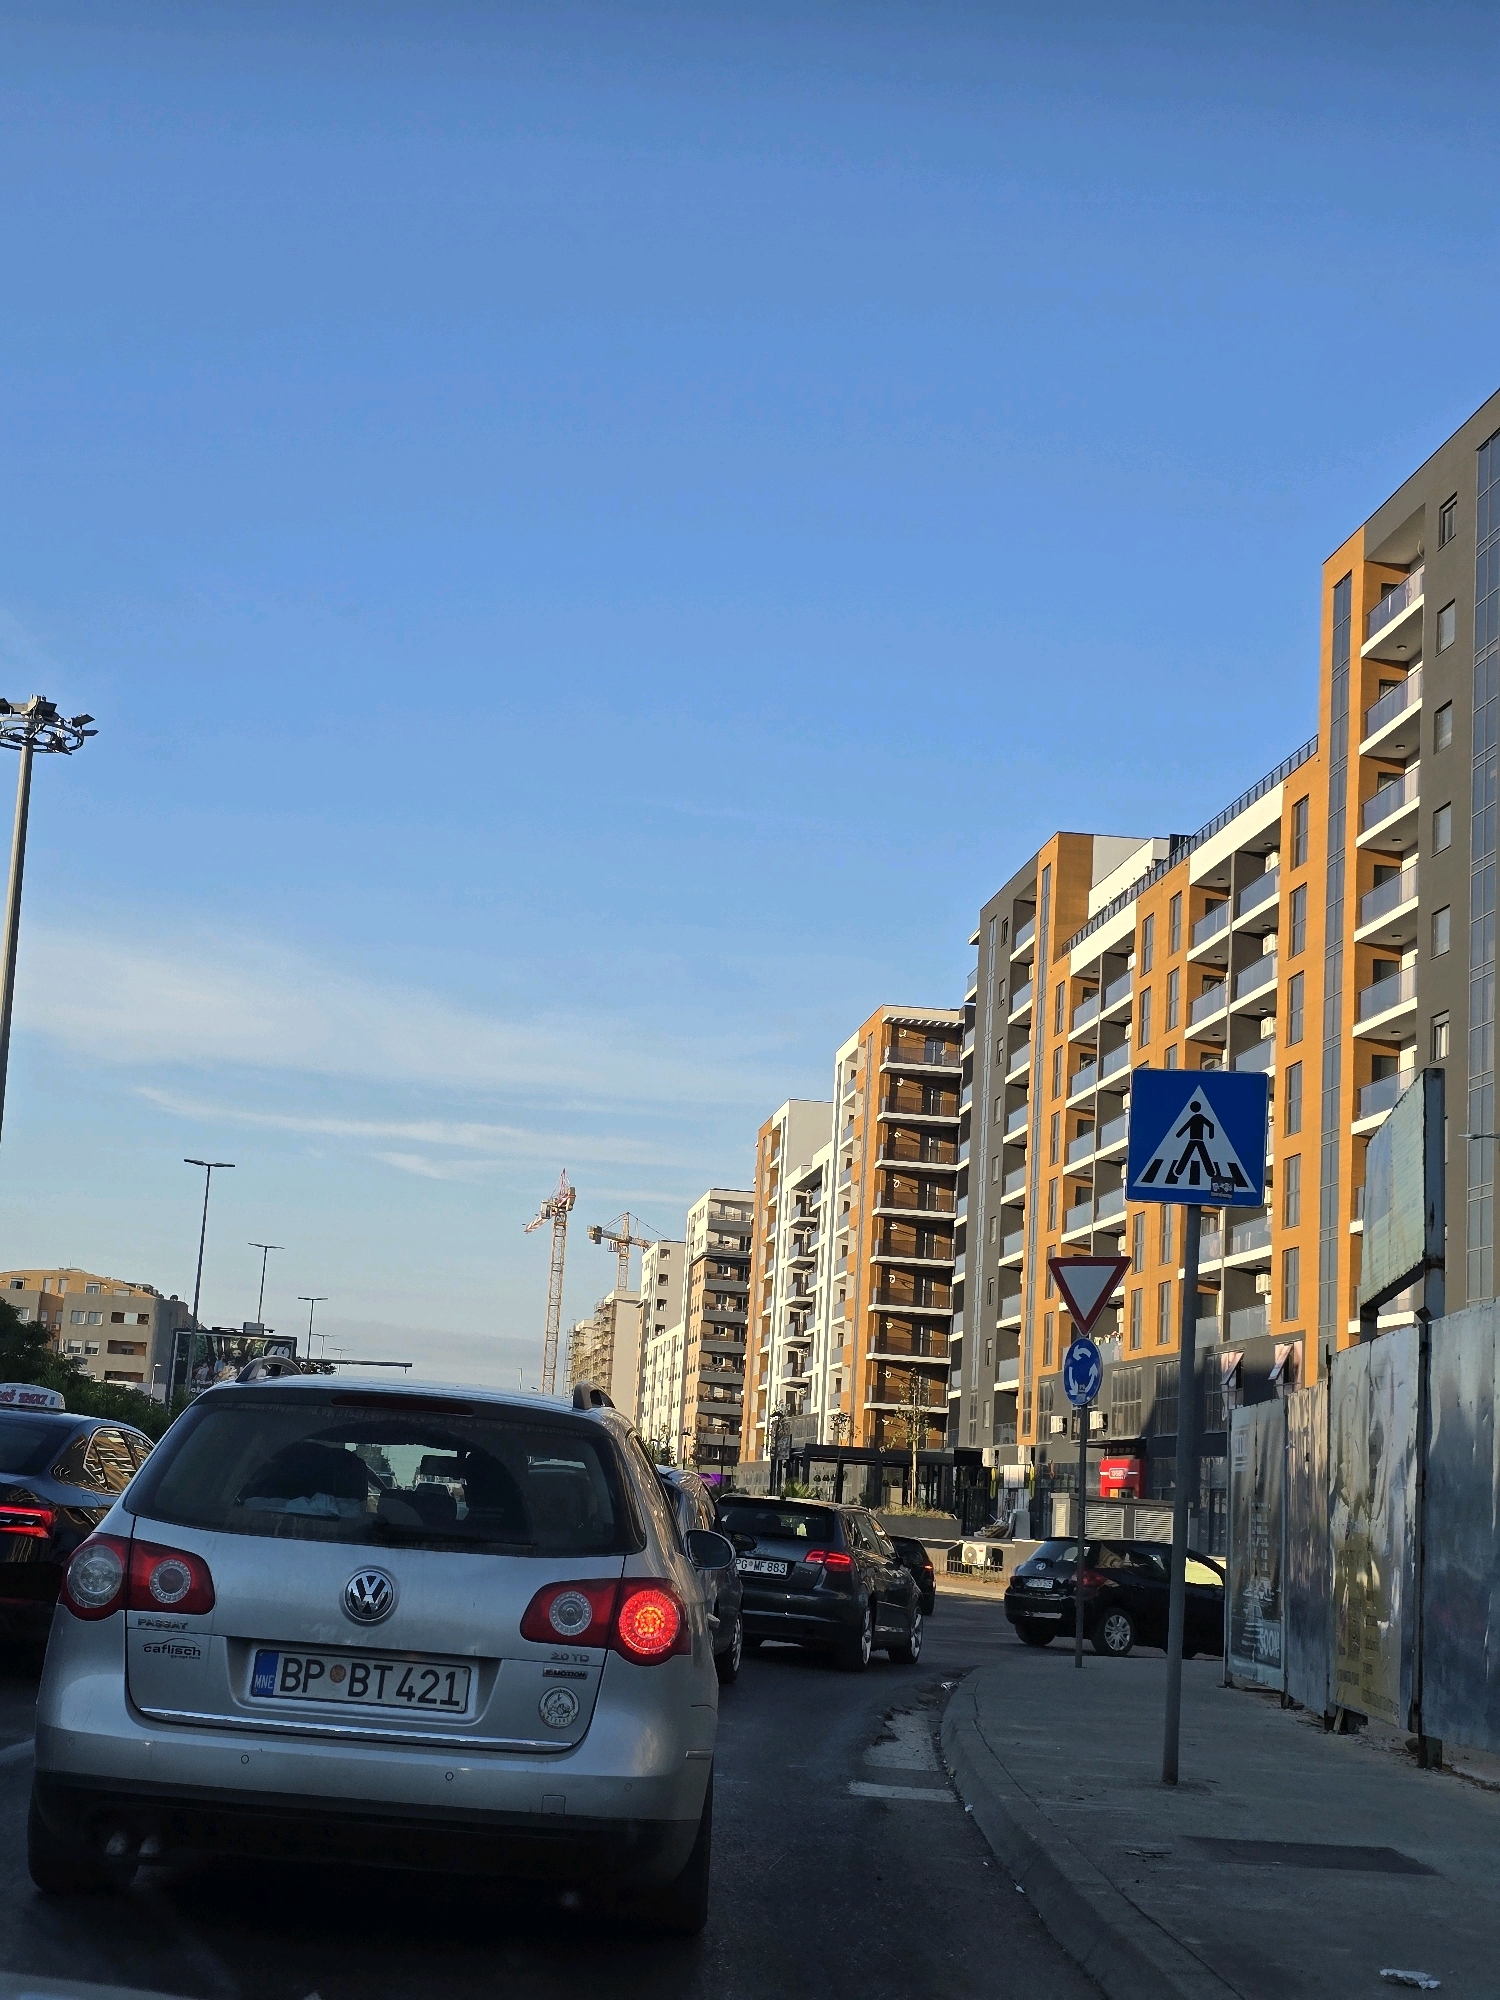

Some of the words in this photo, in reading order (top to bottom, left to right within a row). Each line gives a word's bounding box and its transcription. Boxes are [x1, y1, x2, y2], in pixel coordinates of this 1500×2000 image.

[0, 1389, 16, 1402] AŠ
[18, 1392, 48, 1405] TAXI
[736, 1559, 748, 1569] PG
[137, 1618, 189, 1630] PASSAT
[143, 1644, 201, 1656] caflisch
[254, 1674, 276, 1690] MNE
[279, 1657, 325, 1693] BP
